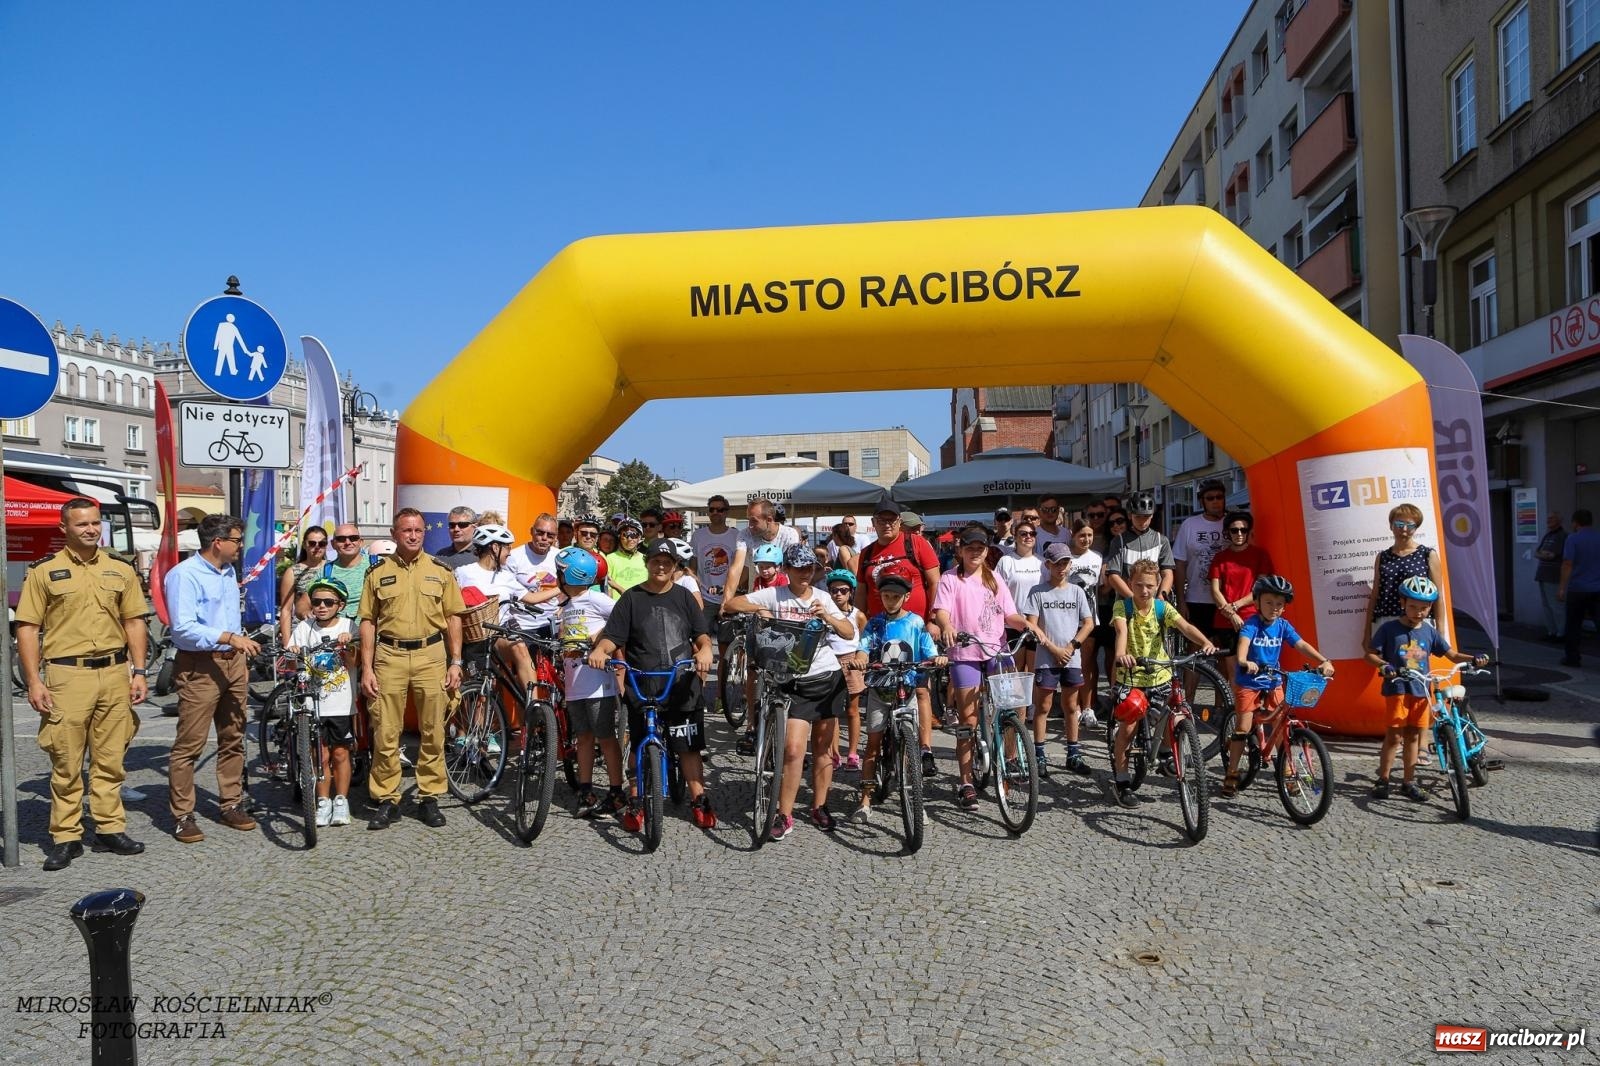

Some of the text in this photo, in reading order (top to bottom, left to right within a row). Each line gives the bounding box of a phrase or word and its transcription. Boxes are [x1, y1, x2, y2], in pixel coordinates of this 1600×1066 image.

[690, 261, 1081, 318] MIASTO RACIBÓRZ
[186, 407, 284, 429] Nie dotyczy
[983, 480, 1031, 494] gelatopiu
[1042, 600, 1077, 609] adidas
[668, 718, 699, 746] FAITH
